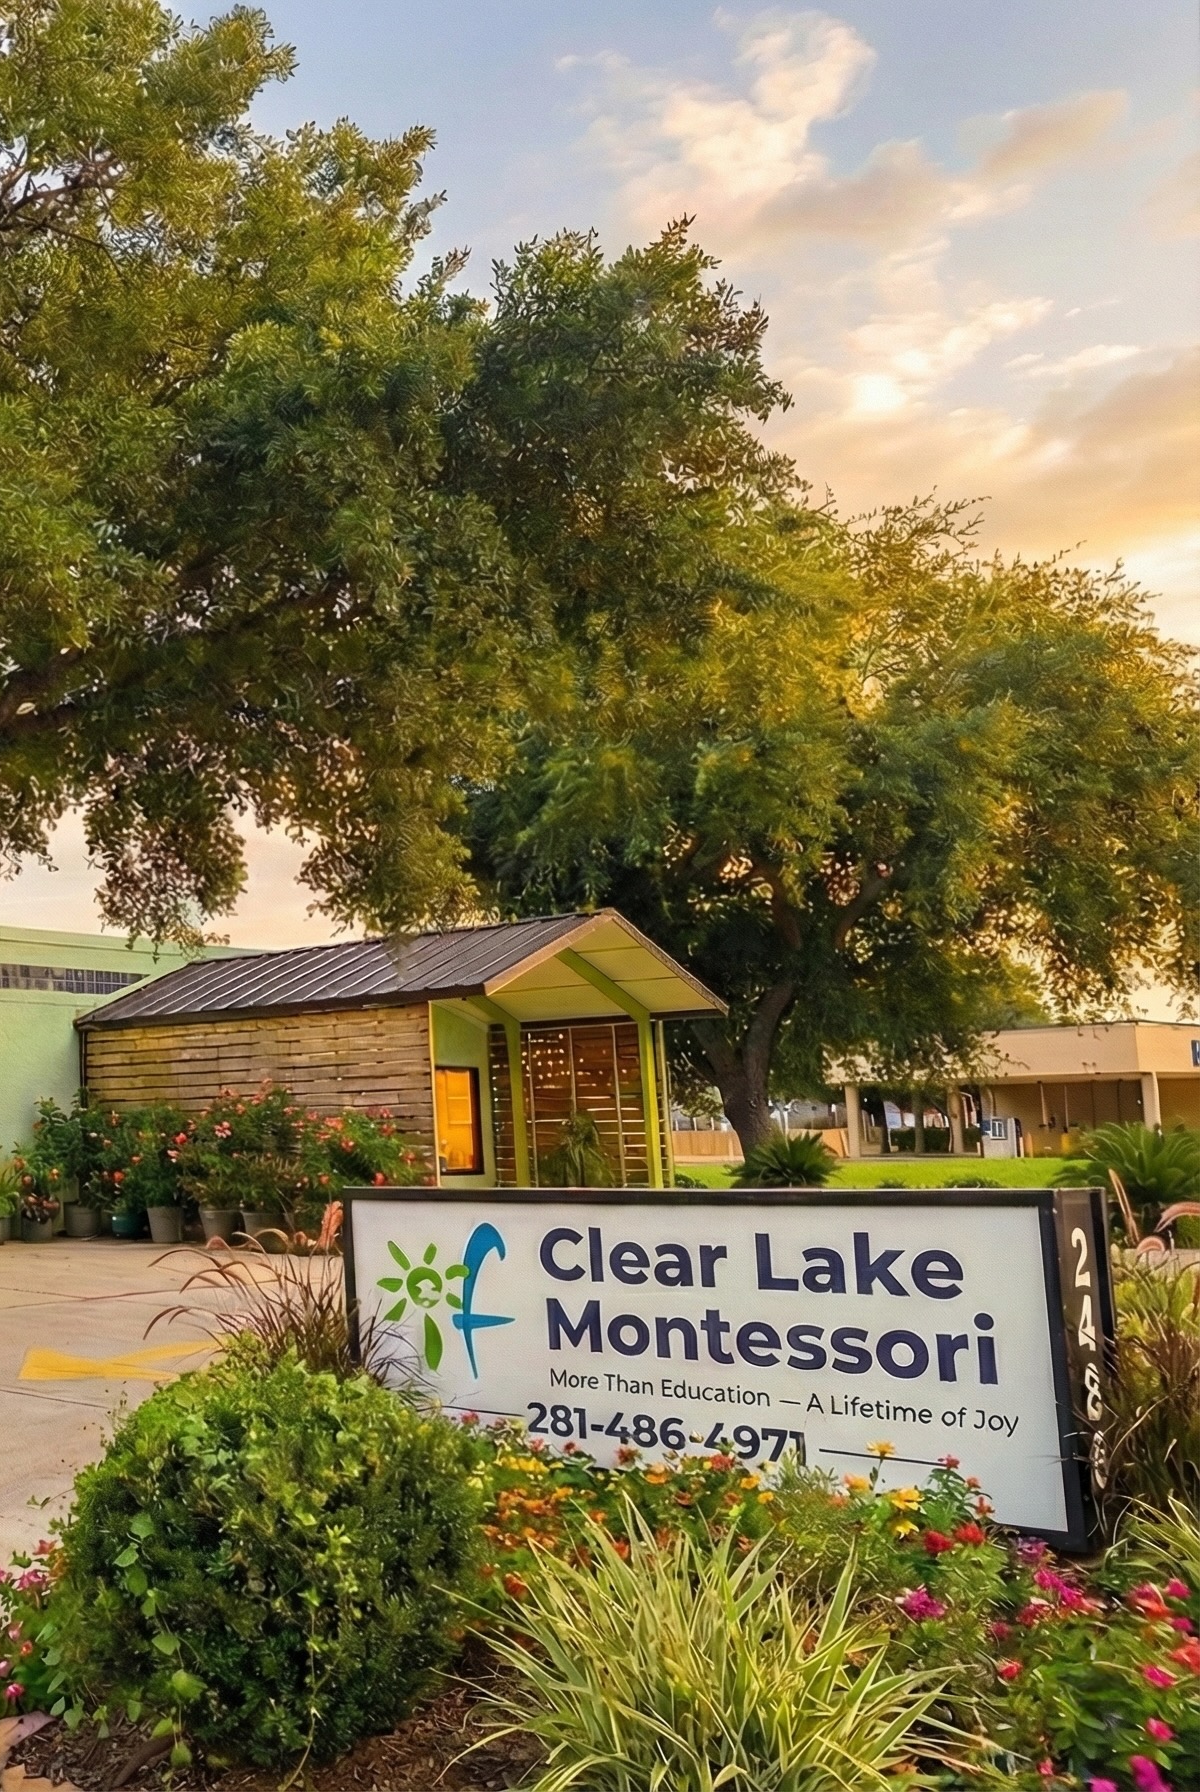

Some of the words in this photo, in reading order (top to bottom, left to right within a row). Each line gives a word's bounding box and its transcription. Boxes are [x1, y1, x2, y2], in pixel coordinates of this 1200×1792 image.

[539, 1226, 728, 1288] Clear
[754, 1231, 964, 1299] Lake
[545, 1297, 998, 1385] Montessori
[550, 1368, 599, 1390] More
[603, 1373, 654, 1396] Than
[661, 1379, 770, 1406] Education
[806, 1393, 824, 1414] A
[830, 1394, 933, 1424] Lifetime
[941, 1407, 967, 1427] of
[973, 1409, 1019, 1438] Joy
